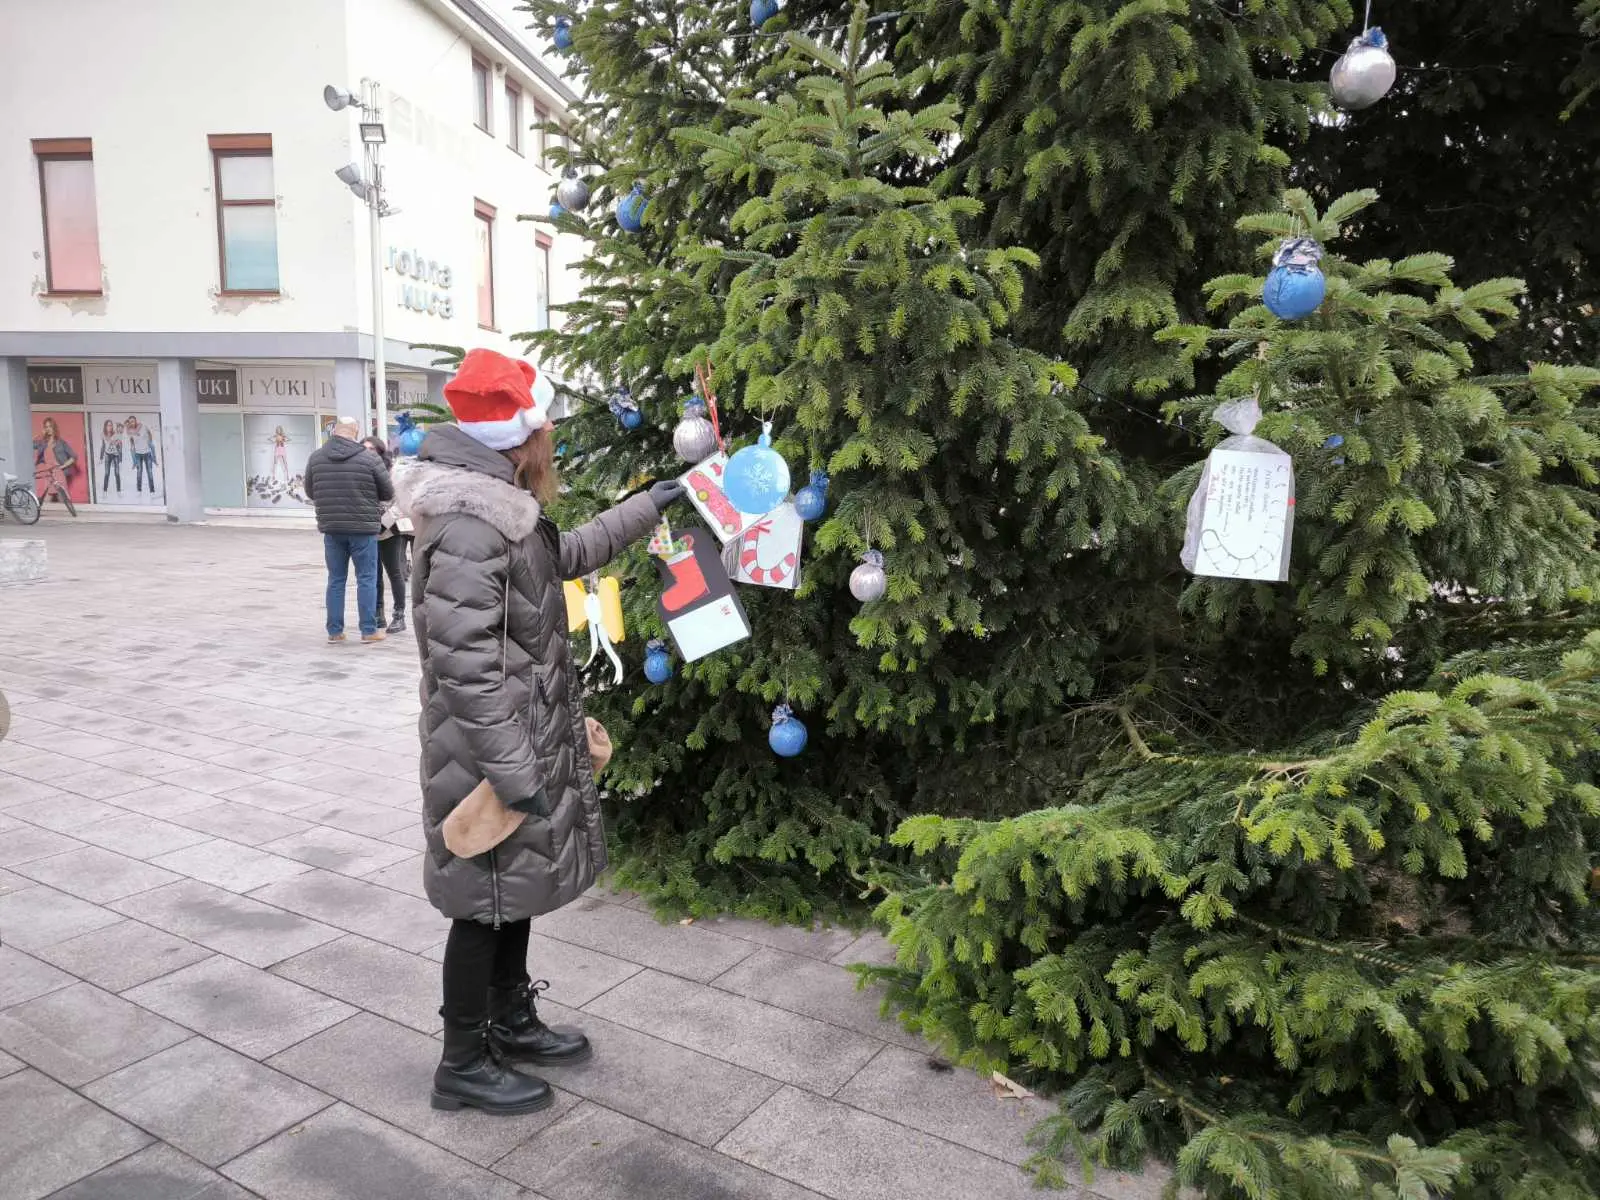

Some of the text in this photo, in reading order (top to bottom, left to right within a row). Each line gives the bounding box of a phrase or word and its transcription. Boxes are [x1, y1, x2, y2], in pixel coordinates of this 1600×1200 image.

[30, 375, 76, 394] YUKI
[106, 375, 152, 394] YUKI
[198, 378, 231, 396] UKI
[260, 376, 308, 396] YUKI
